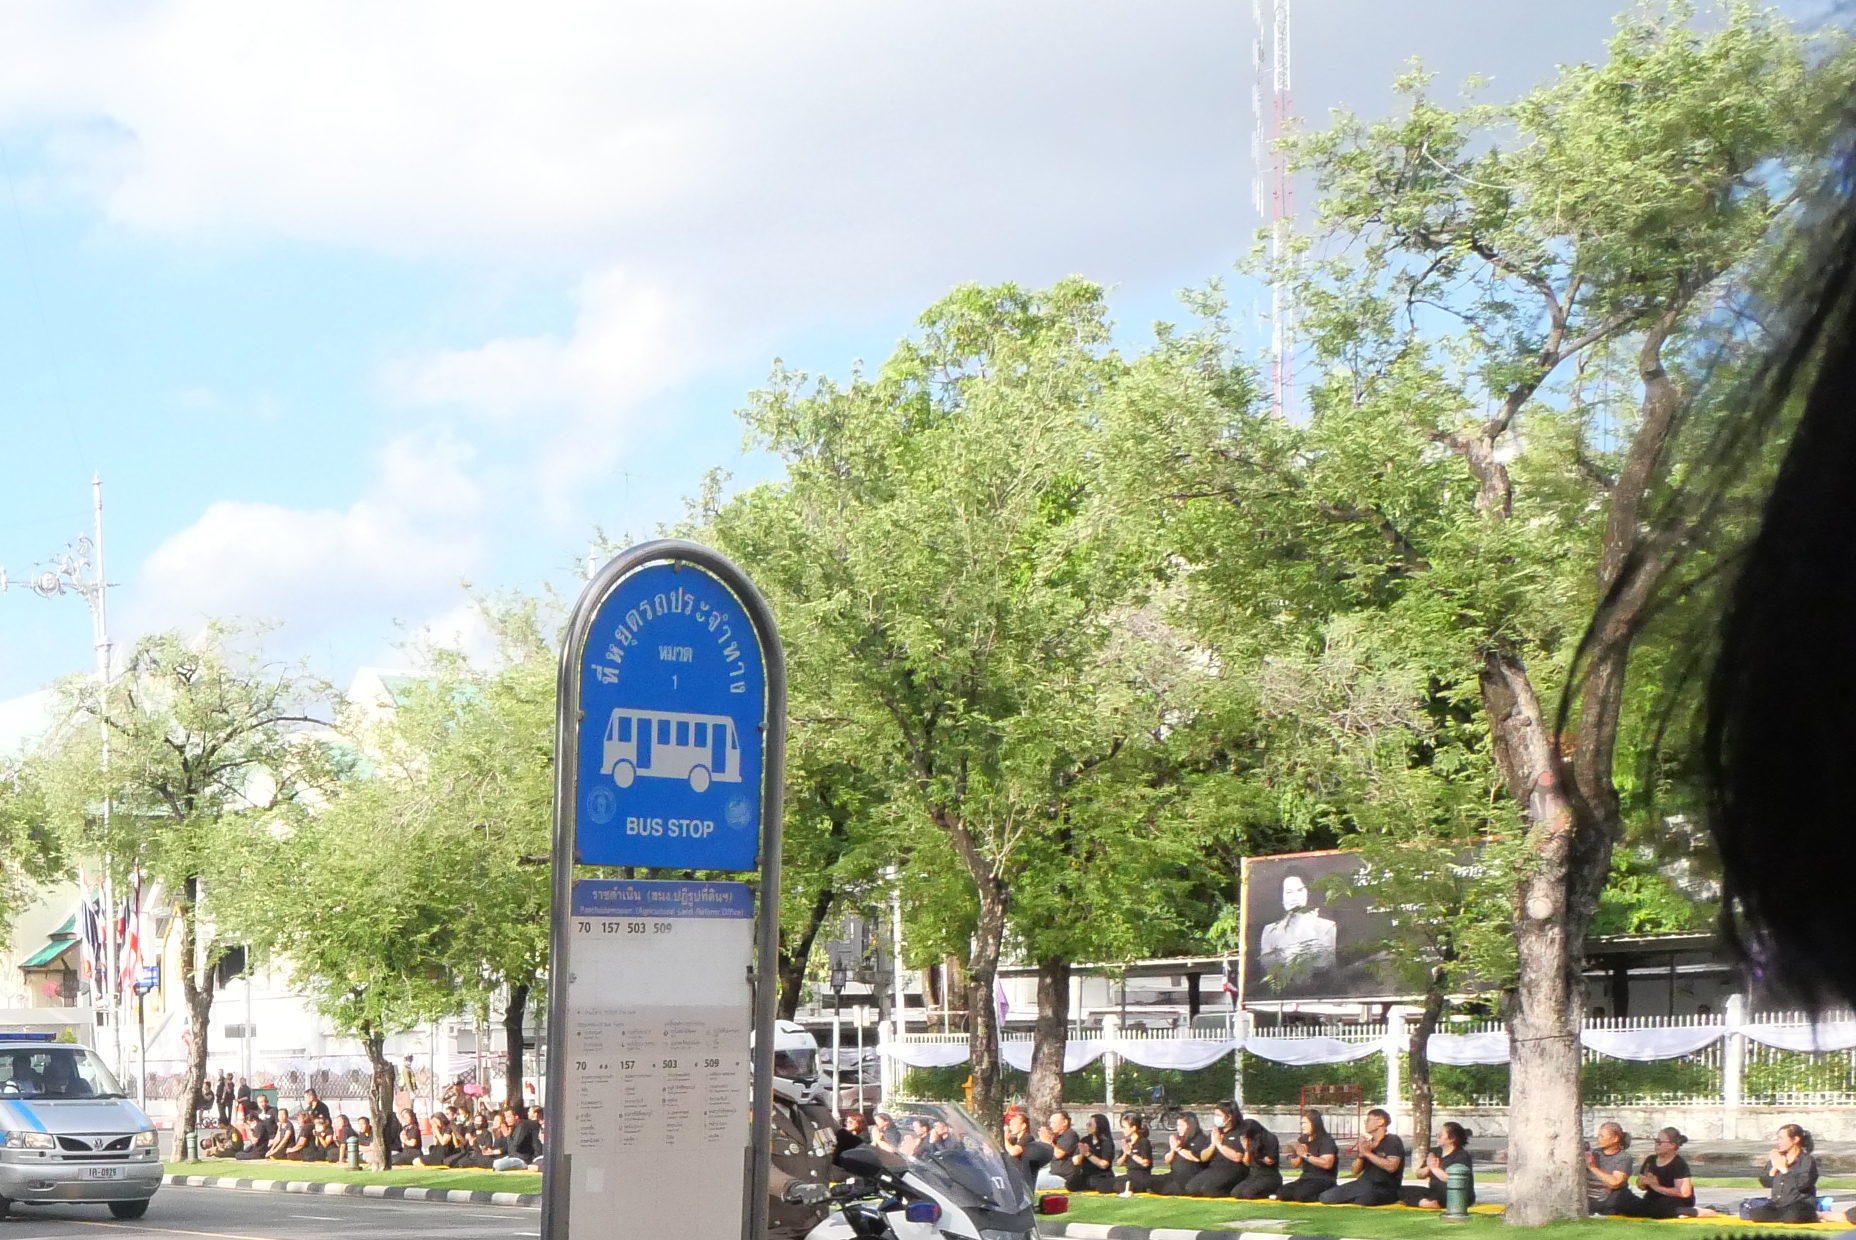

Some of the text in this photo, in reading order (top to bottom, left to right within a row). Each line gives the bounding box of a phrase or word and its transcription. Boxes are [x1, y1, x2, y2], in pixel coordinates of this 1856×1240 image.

[591, 587, 746, 693] ที่หยุดรถประจำทาง
[659, 645, 693, 662] หมวด
[672, 675, 678, 690] 1
[626, 816, 714, 838] BUS STOP
[578, 922, 672, 934] 70 157 503 509
[576, 1061, 587, 1071] 70
[620, 1060, 635, 1070] 157
[662, 1060, 677, 1069] 503
[704, 1058, 719, 1068] 509
[991, 1176, 1005, 1189] 17
